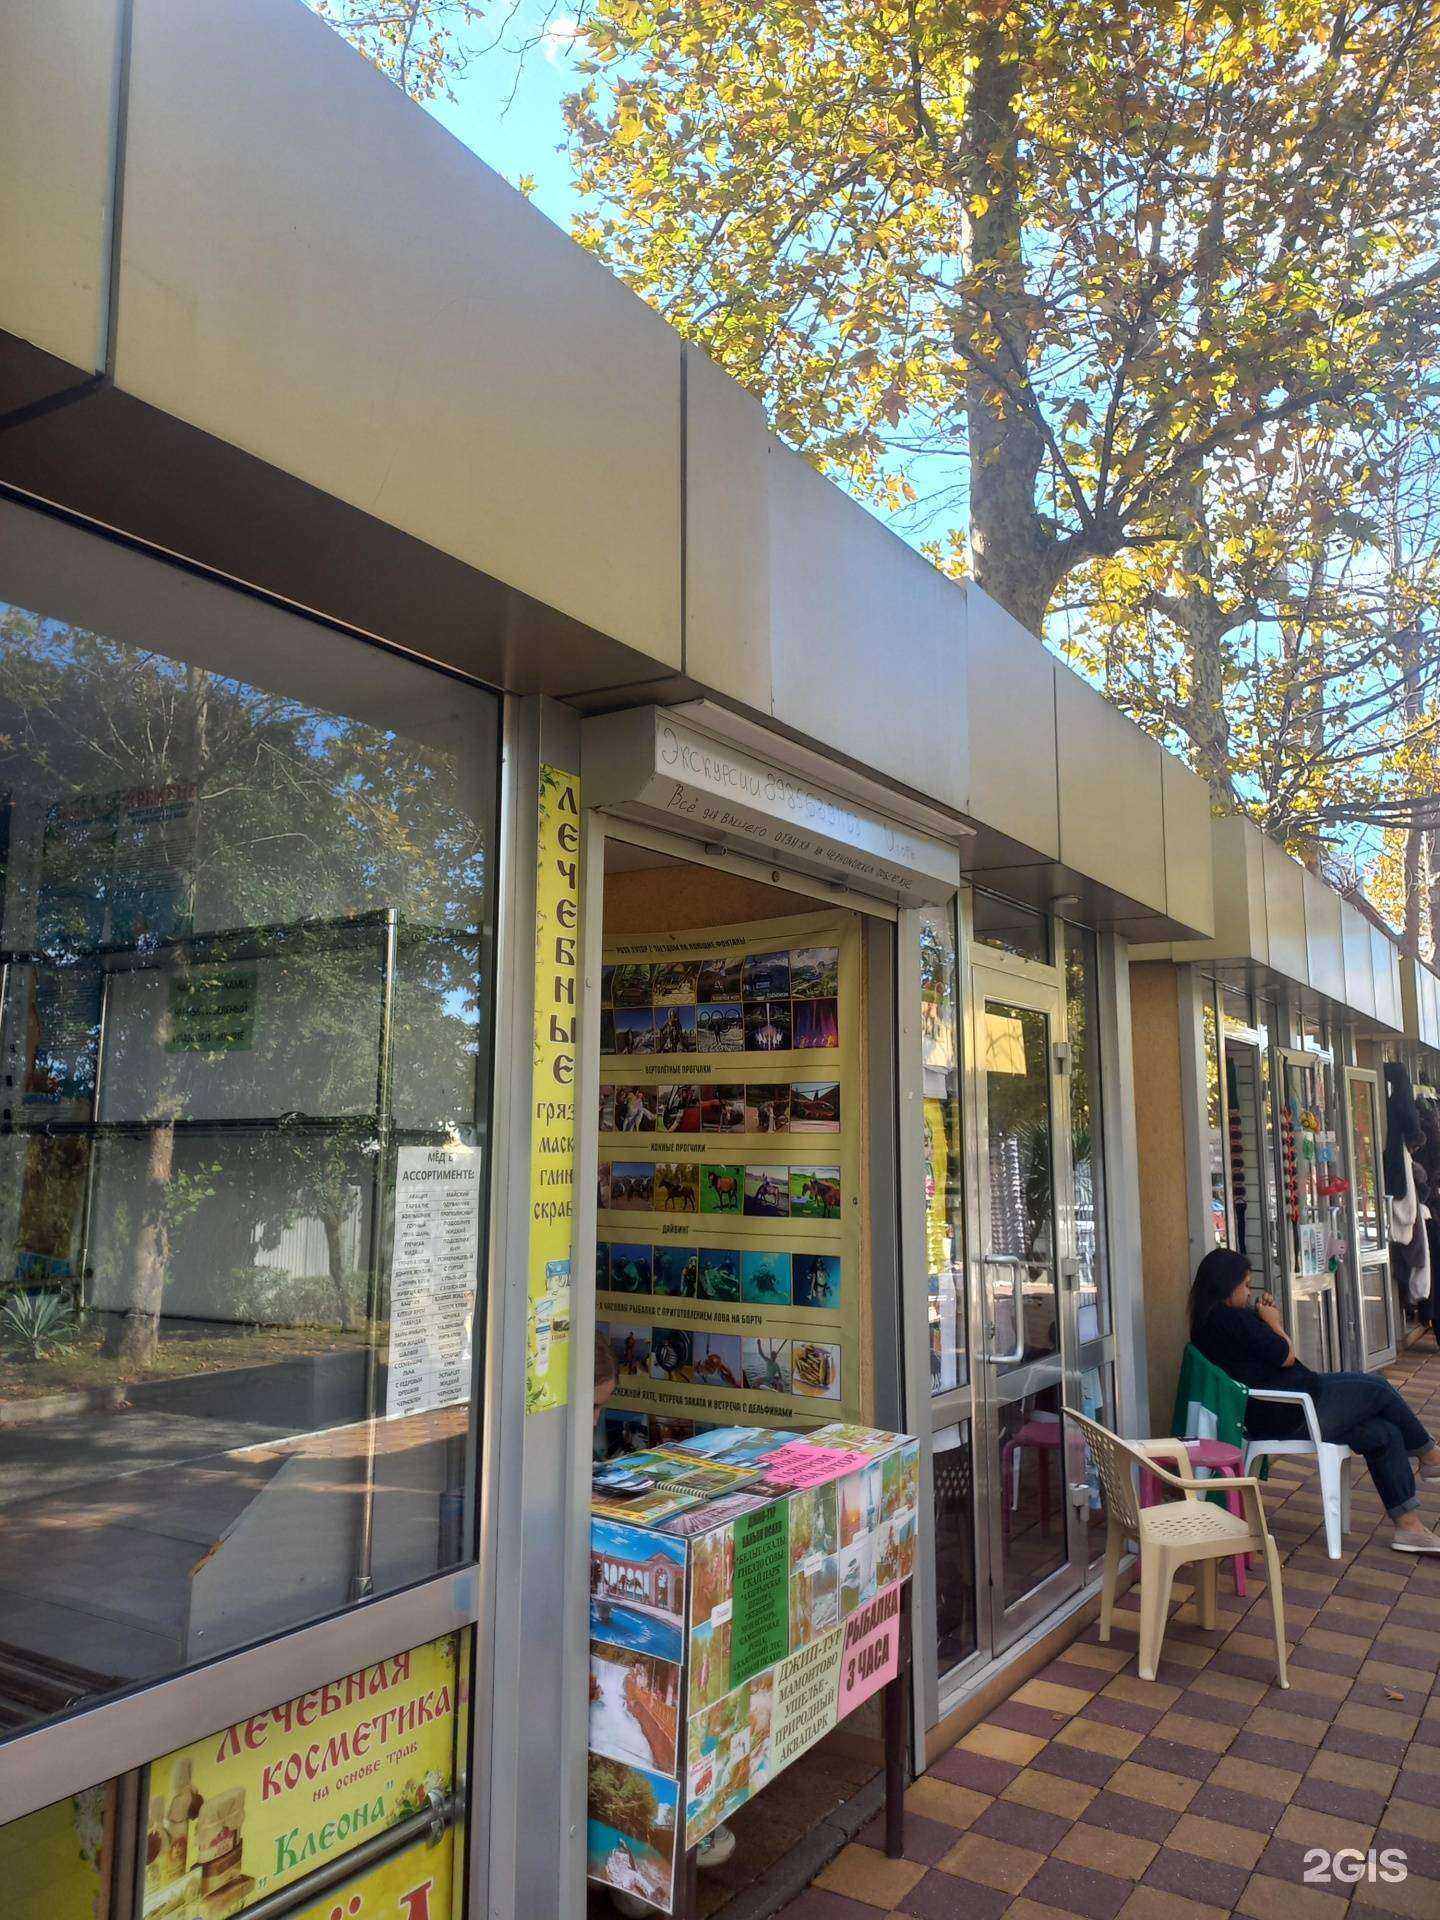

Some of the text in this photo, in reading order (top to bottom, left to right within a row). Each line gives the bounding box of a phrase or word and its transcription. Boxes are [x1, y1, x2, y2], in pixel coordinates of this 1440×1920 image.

[662, 727, 760, 796] Экскурсии
[667, 784, 697, 813] Всё
[402, 1169, 475, 1181] АССОРТИМЕНТЕ:
[846, 1588, 898, 1650] РЫБАЛКА
[778, 1628, 842, 1686] ДЖИП-ТУР
[779, 1651, 838, 1704] МАМОНТОВО
[846, 1633, 890, 1692] 3 ЧАСА
[216, 1651, 411, 1763] ЛЕЧЕБНАЯ
[775, 1688, 835, 1747] ПРИРОДНЫЙ
[262, 1685, 451, 1802] КОСМЕТИКА
[312, 1784, 330, 1802] на
